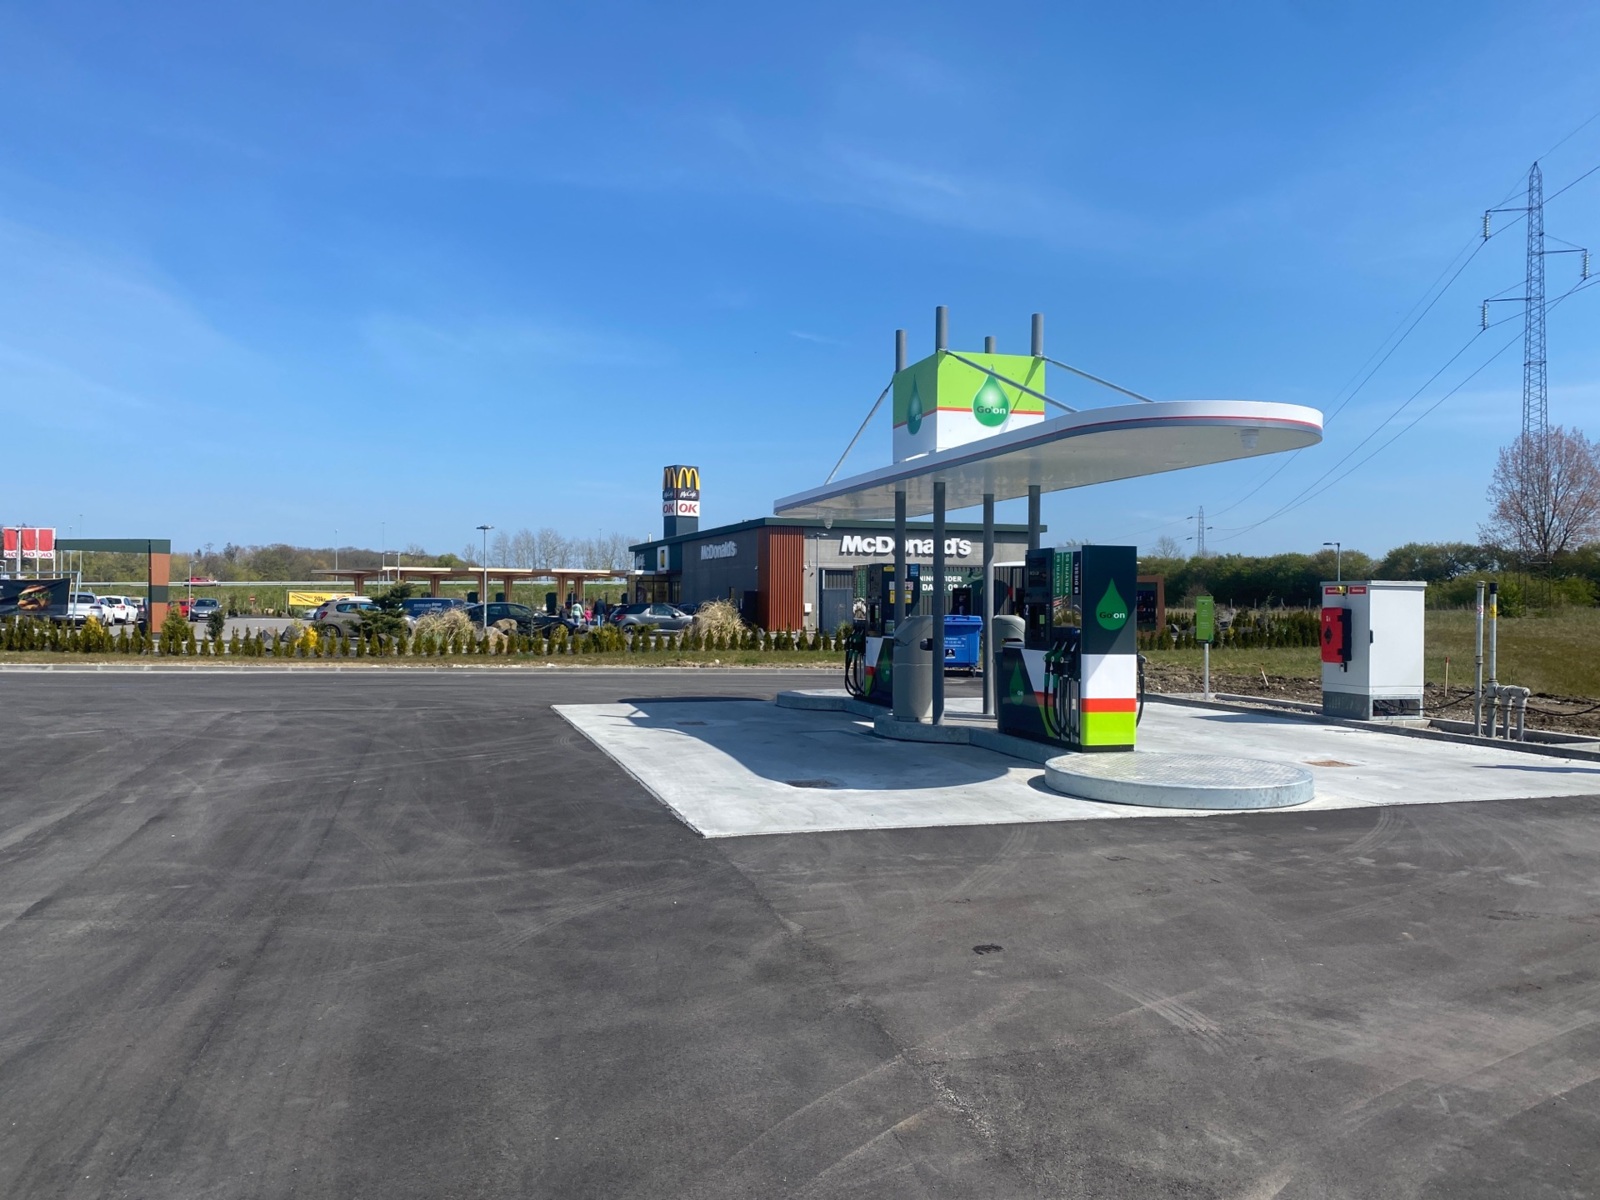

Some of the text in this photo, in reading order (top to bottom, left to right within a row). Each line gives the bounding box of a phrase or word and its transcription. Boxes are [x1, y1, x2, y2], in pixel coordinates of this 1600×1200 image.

[976, 405, 1006, 415] Go'on
[663, 504, 675, 514] OK
[679, 503, 698, 514] OK
[701, 541, 738, 561] McDonald's
[840, 535, 972, 556] McDnad's
